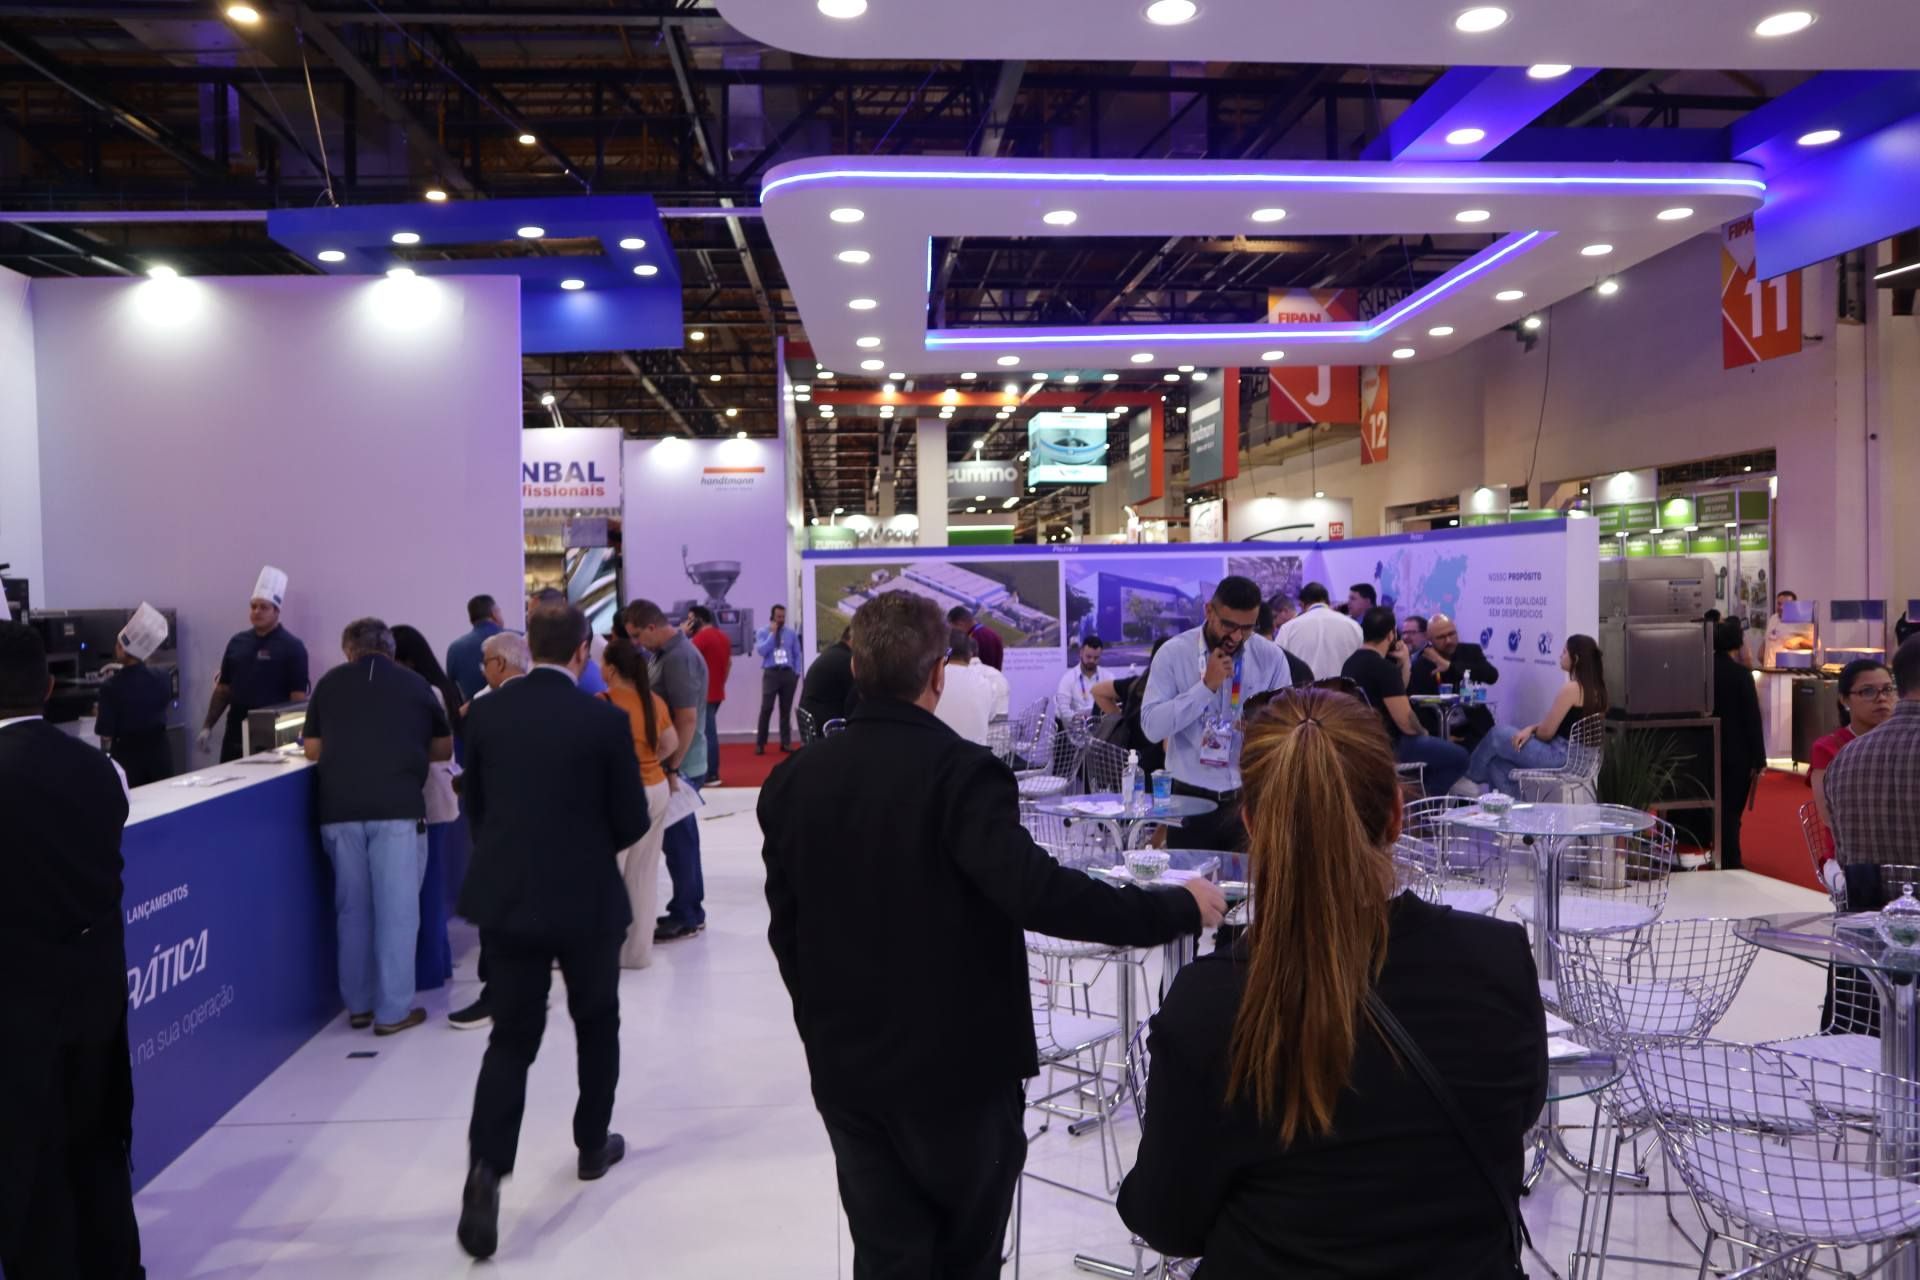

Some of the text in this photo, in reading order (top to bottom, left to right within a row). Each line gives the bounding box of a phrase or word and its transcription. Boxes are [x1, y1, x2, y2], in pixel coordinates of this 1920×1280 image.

[1744, 274, 1788, 338] 11
[1278, 312, 1321, 323] FIPAN
[1305, 365, 1331, 406] J
[1369, 411, 1387, 449] 12
[522, 461, 605, 482] NBAL
[947, 467, 1018, 483] zummo
[700, 475, 754, 486] handtmann
[522, 484, 605, 497] fissionais
[1508, 571, 1542, 581] PROPÓSITO
[1505, 596, 1513, 605] DE
[1514, 596, 1547, 607] QUALIDADE
[1489, 608, 1501, 617] SEM
[127, 883, 189, 924] LANÇAMENTOS
[137, 1037, 155, 1065] na
[157, 1020, 180, 1052] sua
[182, 984, 234, 1034] operação
